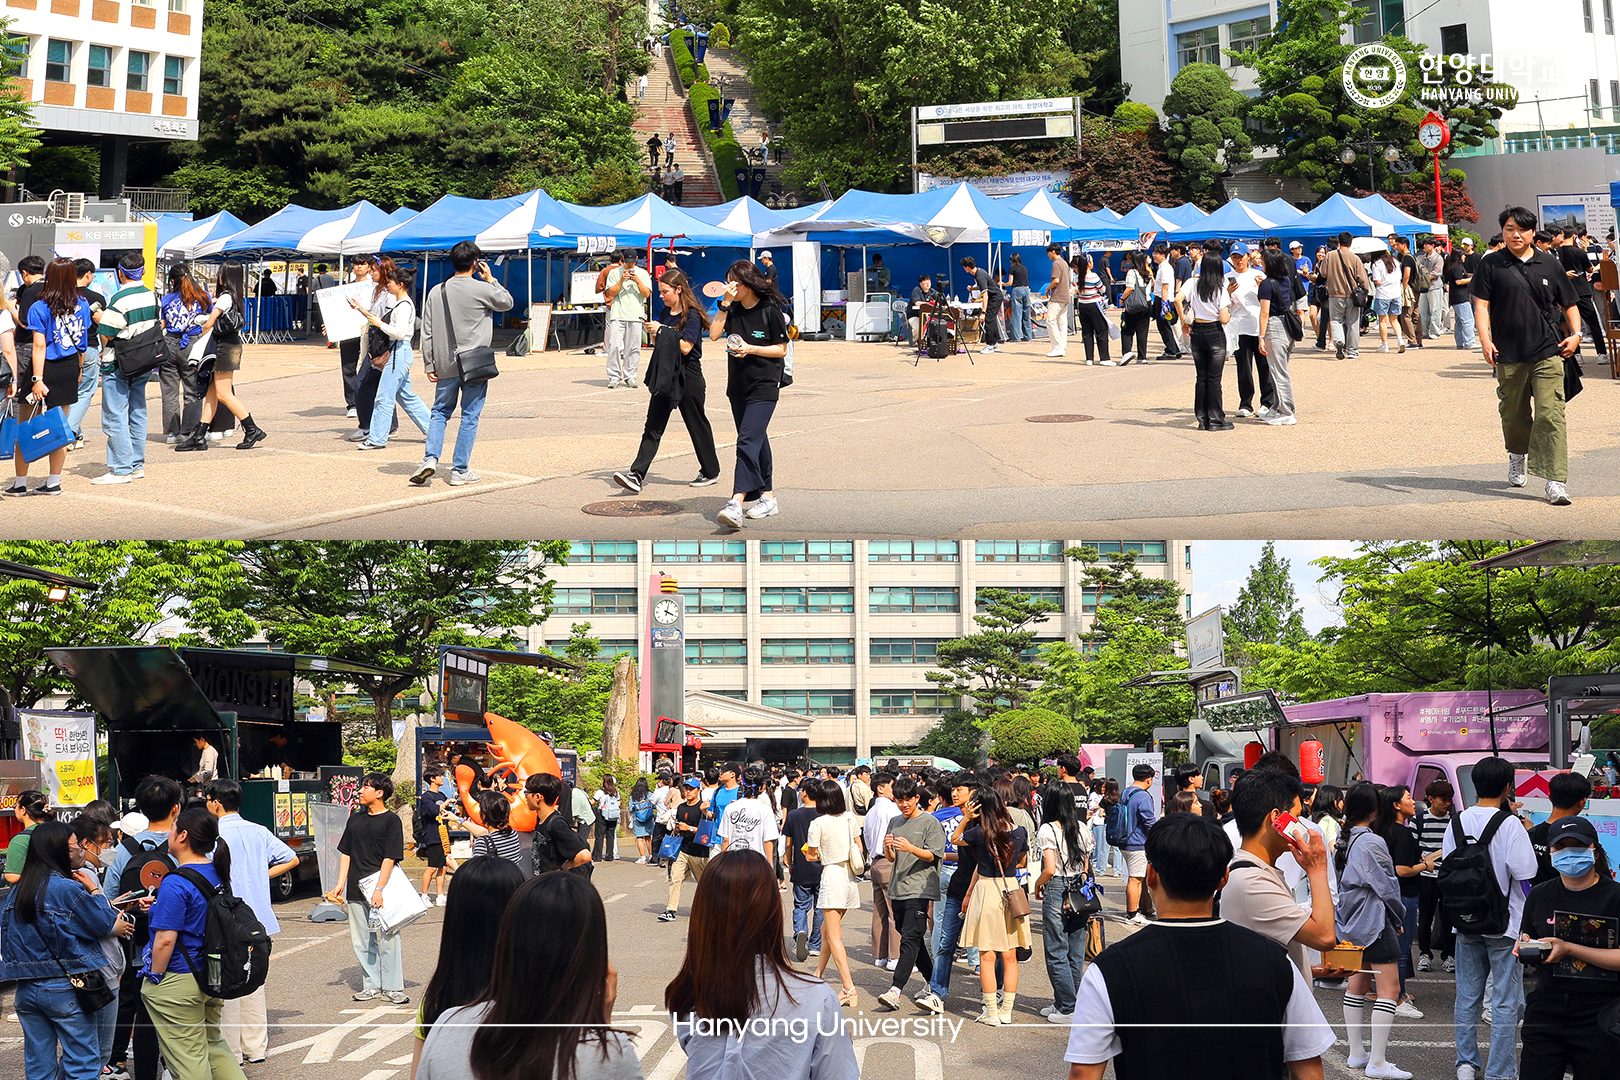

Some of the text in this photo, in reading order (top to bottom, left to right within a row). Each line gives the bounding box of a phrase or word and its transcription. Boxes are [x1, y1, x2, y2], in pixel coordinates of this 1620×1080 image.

[1026, 101, 1054, 110] 한양대학교
[85, 231, 102, 240] KB
[199, 665, 292, 710] MONSTER
[1420, 707, 1450, 715] #케이터링
[55, 727, 68, 742] 딱!
[77, 775, 94, 787] 5,000
